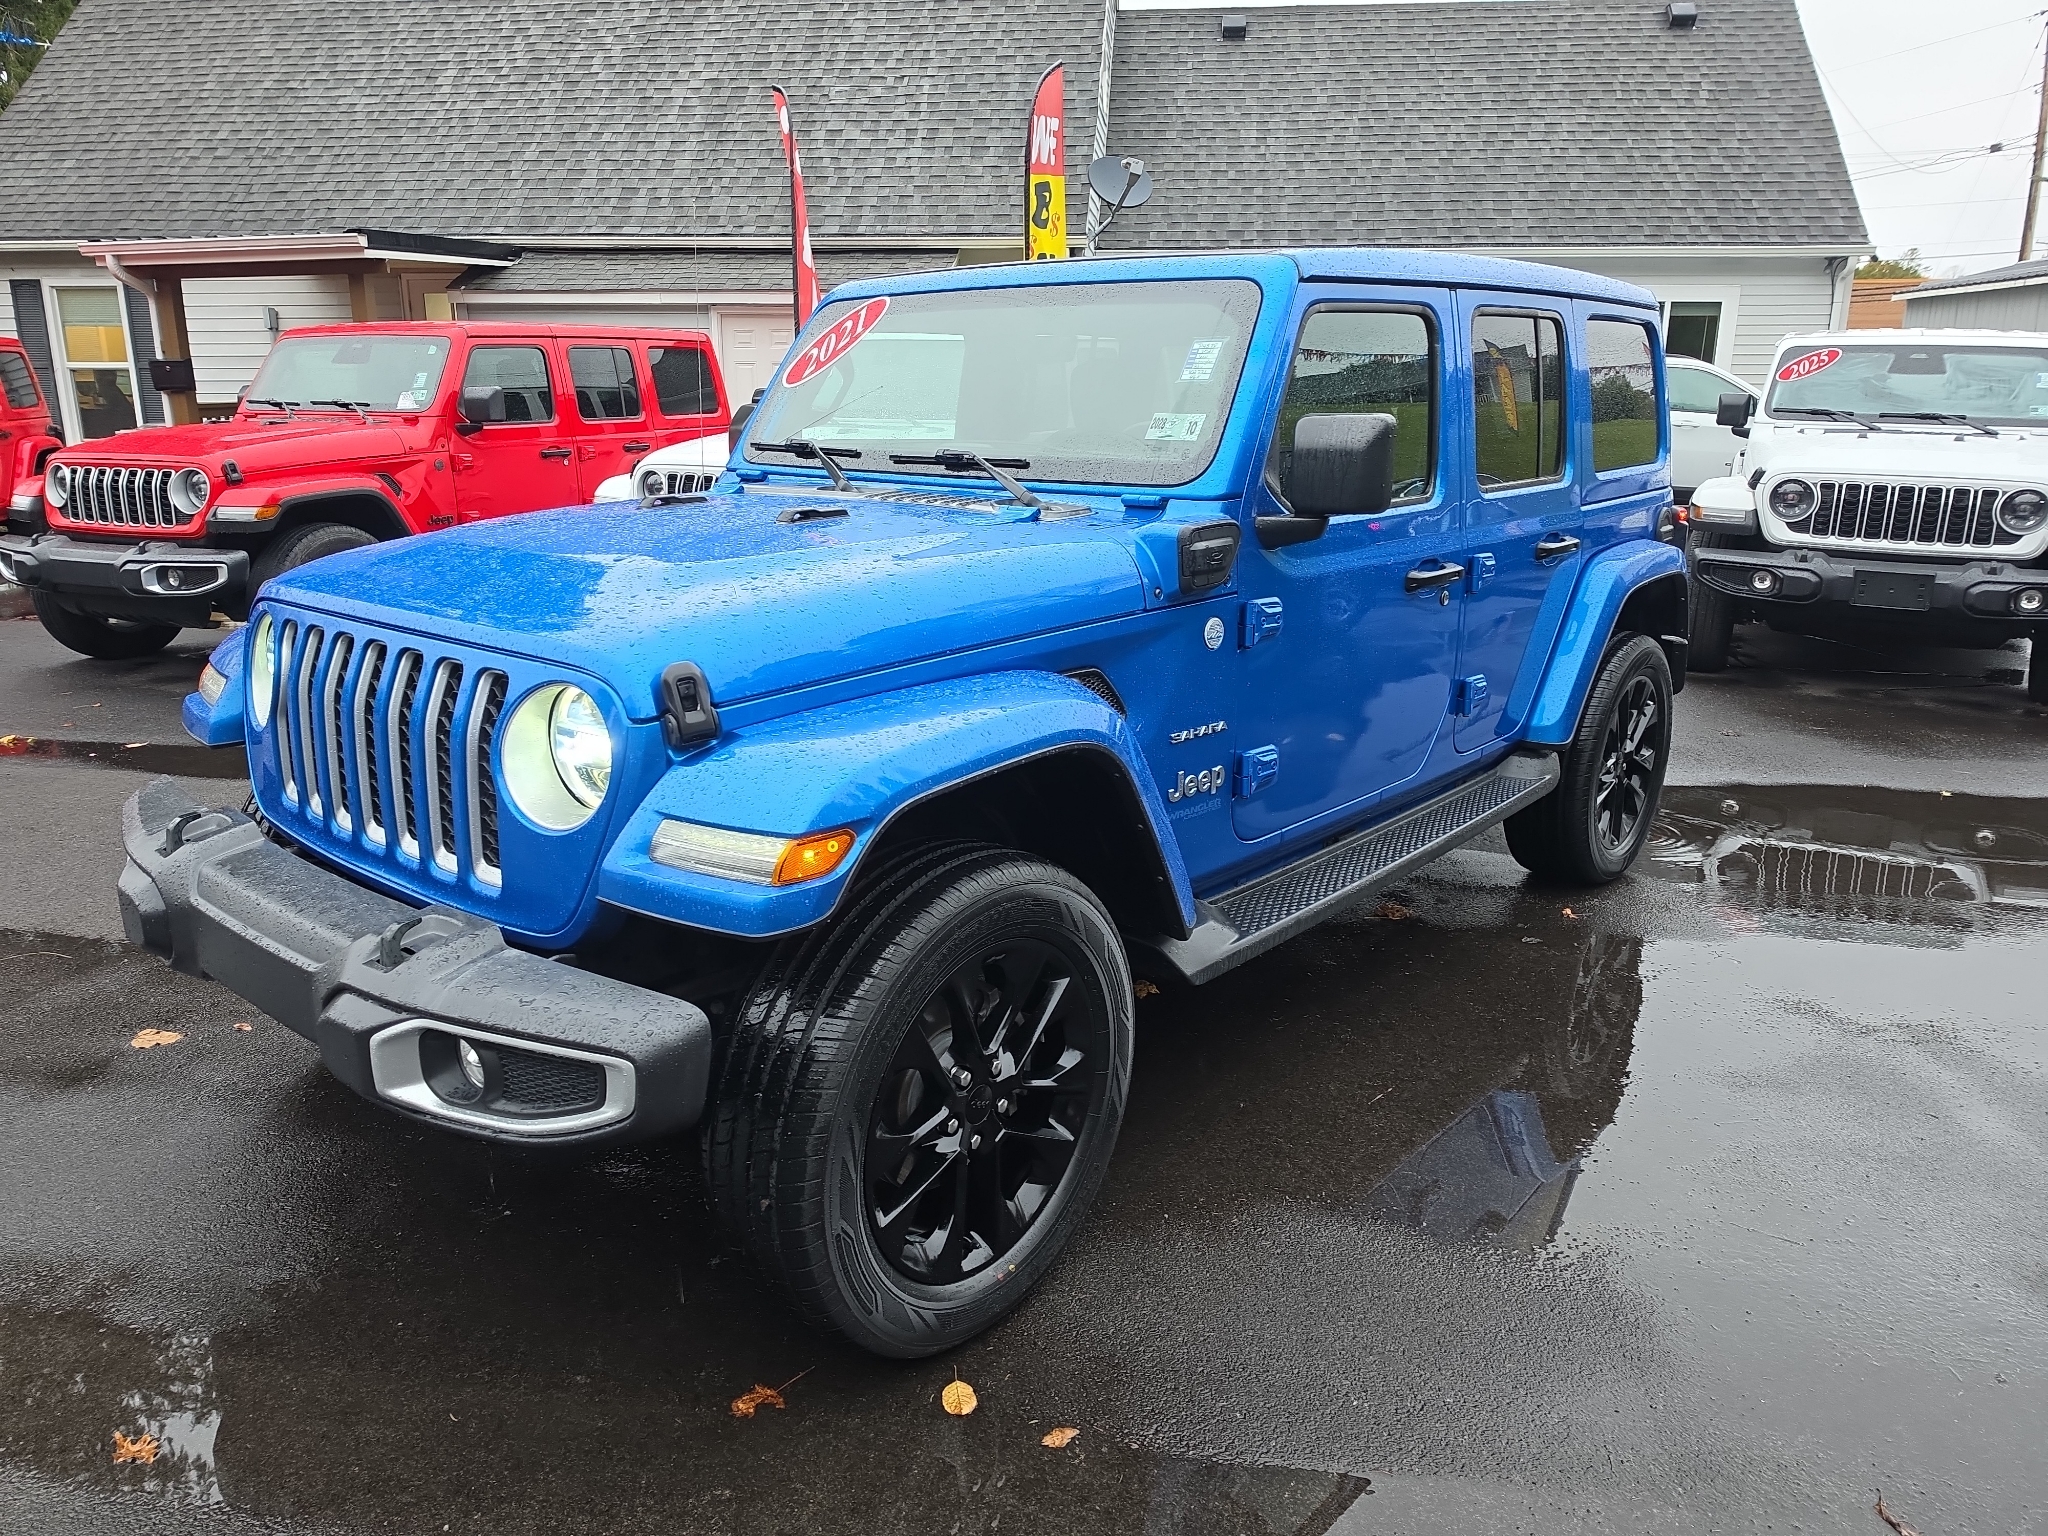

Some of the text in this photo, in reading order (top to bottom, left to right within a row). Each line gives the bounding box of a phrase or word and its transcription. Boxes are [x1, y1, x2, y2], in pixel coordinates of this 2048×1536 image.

[1031, 114, 1060, 166] WE
[801, 305, 868, 379] 2021
[1789, 350, 1830, 380] 2025
[1185, 420, 1198, 436] 10
[426, 513, 454, 526] Jeep
[1168, 720, 1229, 744] SAHARA
[1167, 764, 1226, 803] Jeep
[1168, 798, 1222, 820] WRANGLER
